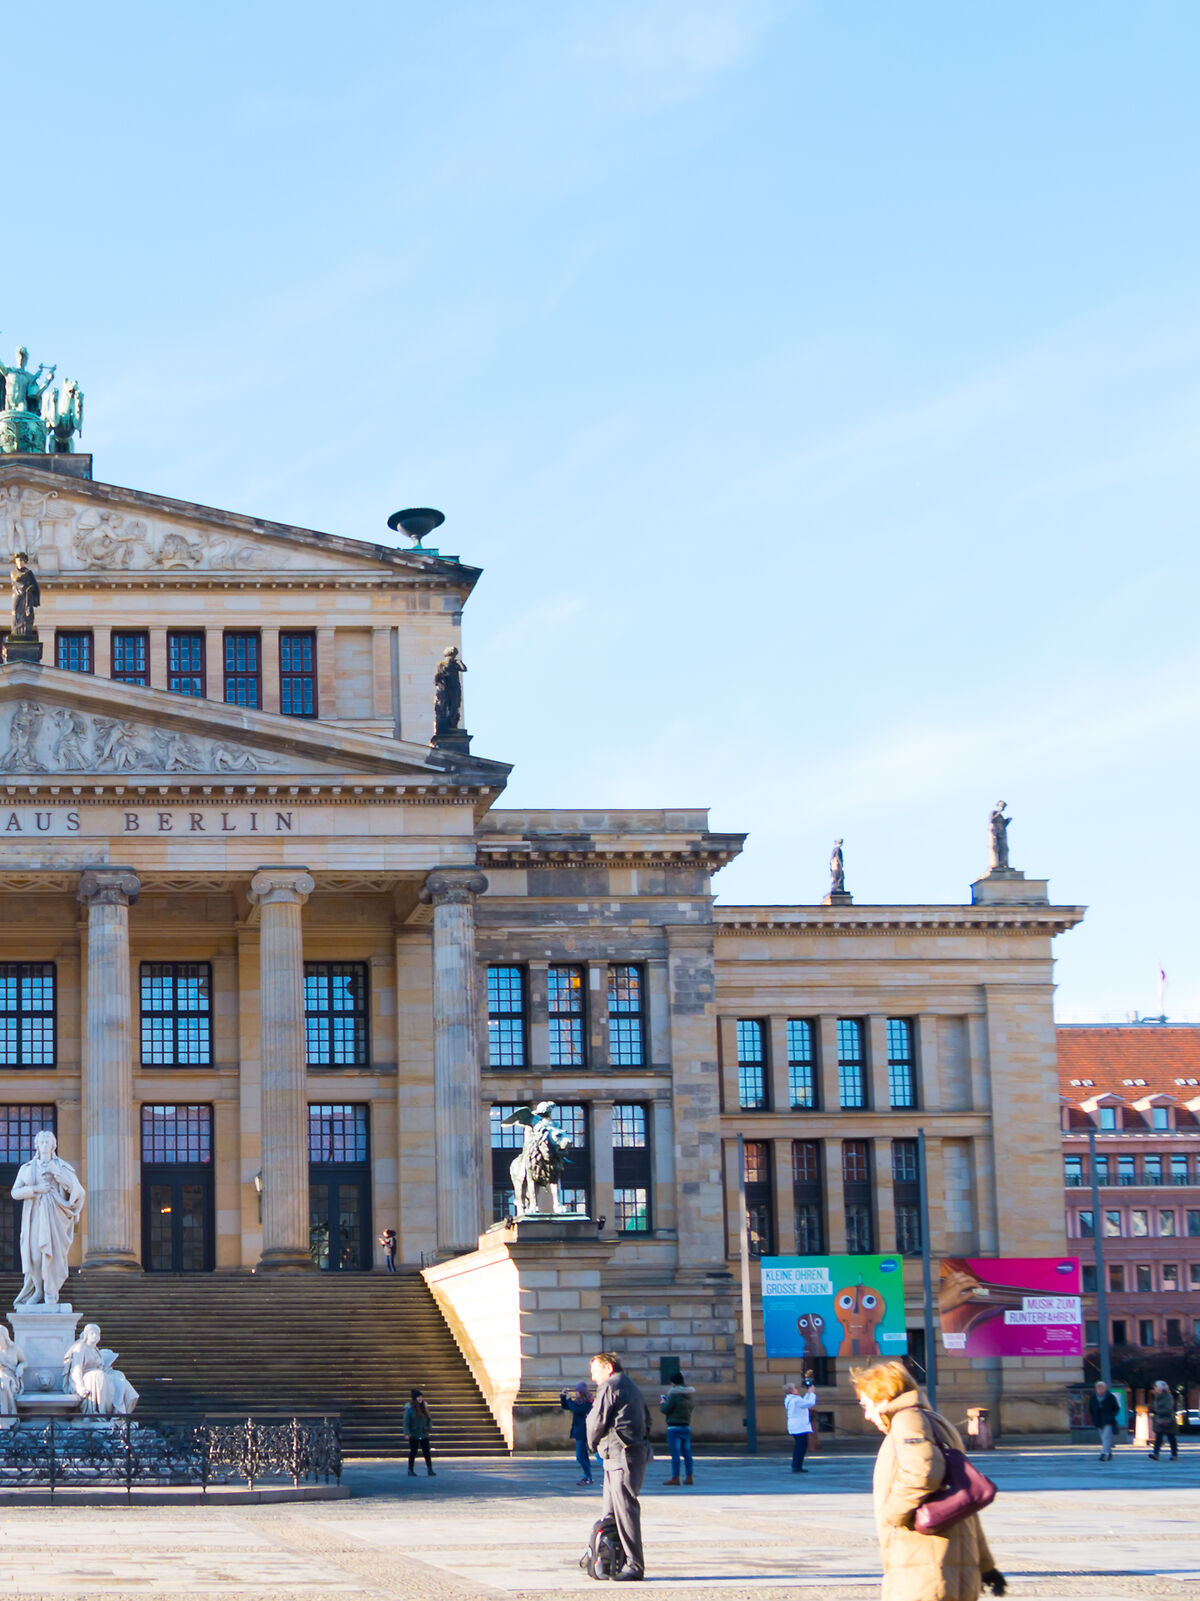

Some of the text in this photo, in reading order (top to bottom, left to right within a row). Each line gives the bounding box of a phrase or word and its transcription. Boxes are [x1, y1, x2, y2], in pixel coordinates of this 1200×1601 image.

[123, 811, 294, 832] BERLIN
[765, 1270, 793, 1281] KLEINE
[766, 1283, 797, 1294] GROSSE
[1027, 1298, 1076, 1309] MUSIK ZUM
[1008, 1311, 1077, 1323] RUNTERFAHREN
